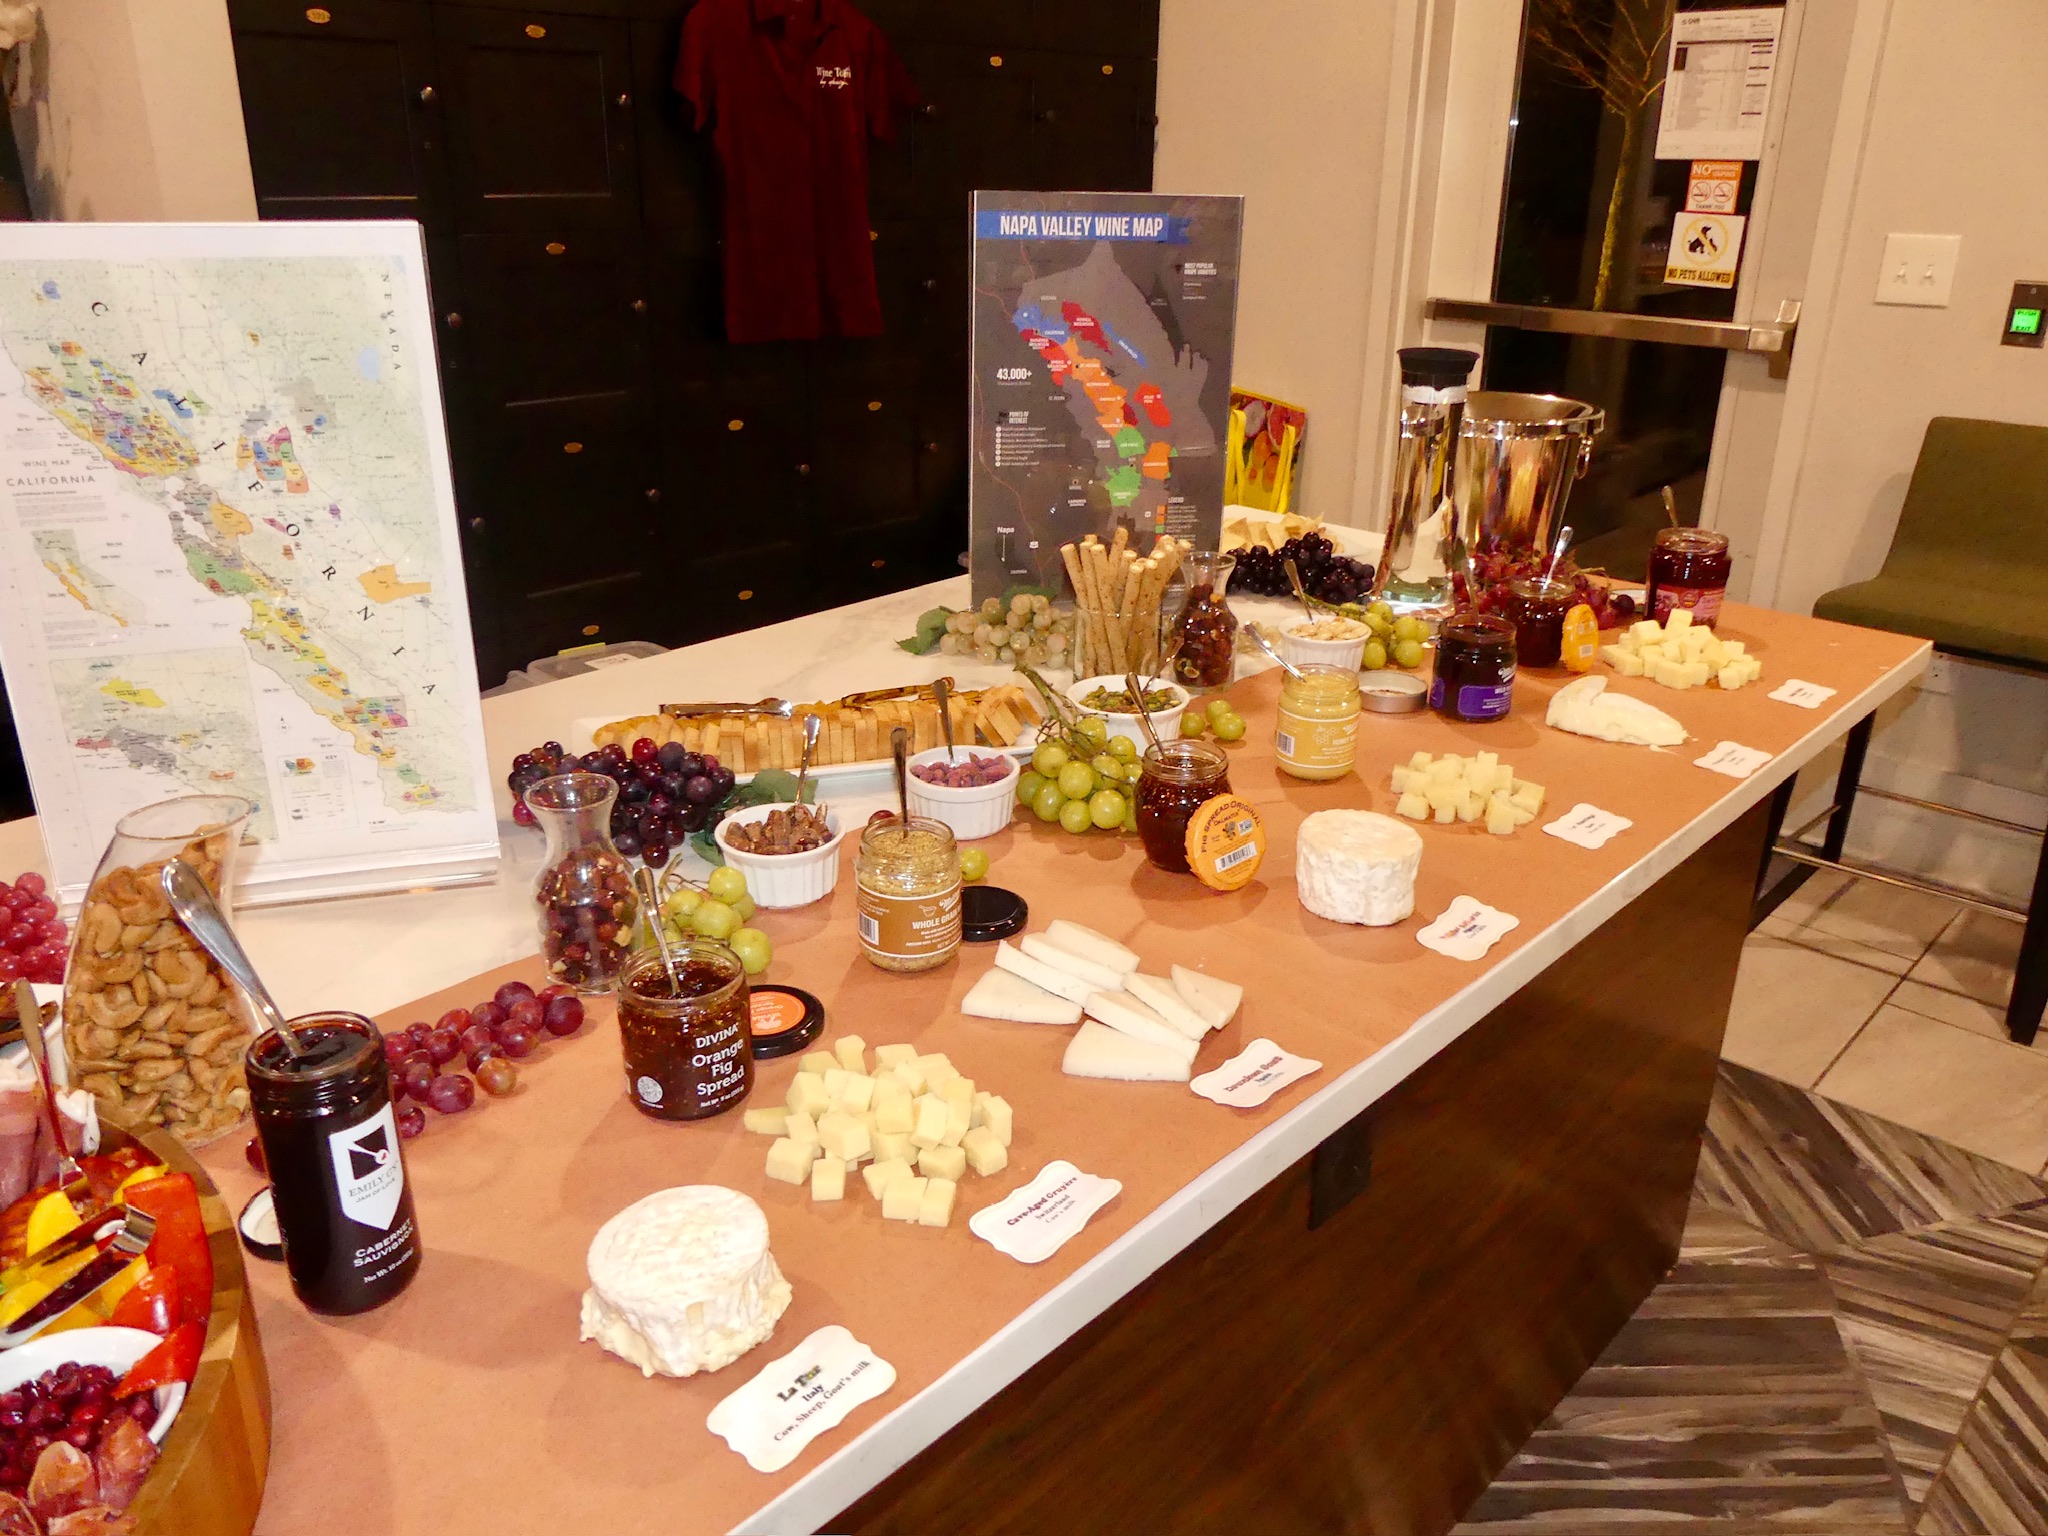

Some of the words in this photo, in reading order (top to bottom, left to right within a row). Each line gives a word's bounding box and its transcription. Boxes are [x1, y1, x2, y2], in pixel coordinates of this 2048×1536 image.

[1692, 163, 1711, 175] NO
[1000, 215, 1037, 236] NAPA
[1041, 216, 1091, 236] VALLEY
[1095, 217, 1129, 237] WINE
[1133, 217, 1163, 237] MAP
[1679, 269, 1697, 280] PETS
[1698, 270, 1731, 283] ALLOWED
[381, 274, 401, 371] NEVADA
[996, 368, 1032, 381] 43,000+
[23, 460, 47, 468] WINE
[6, 475, 96, 487] CALIFORNIA
[1204, 803, 1230, 833] SPREAD
[1230, 801, 1261, 827] ORIGINAL
[911, 917, 940, 930] WHOLE
[695, 1023, 739, 1048] DIVINA
[692, 1038, 744, 1067] Orange
[711, 1060, 733, 1077] Fig
[697, 1065, 745, 1096] Spread
[349, 1174, 384, 1197] EMILY
[1007, 1196, 1048, 1226] Cave-Aged
[1035, 1193, 1071, 1220] Switzerland
[353, 1225, 414, 1267] SAUVIGNON
[355, 1217, 411, 1257] CABERNET
[774, 1424, 799, 1441] Cow,
[795, 1400, 827, 1423] Sheep,
[823, 1376, 852, 1400] Goat's
[850, 1360, 871, 1378] milk
[776, 1386, 798, 1402] La
[801, 1384, 825, 1402] Italy
